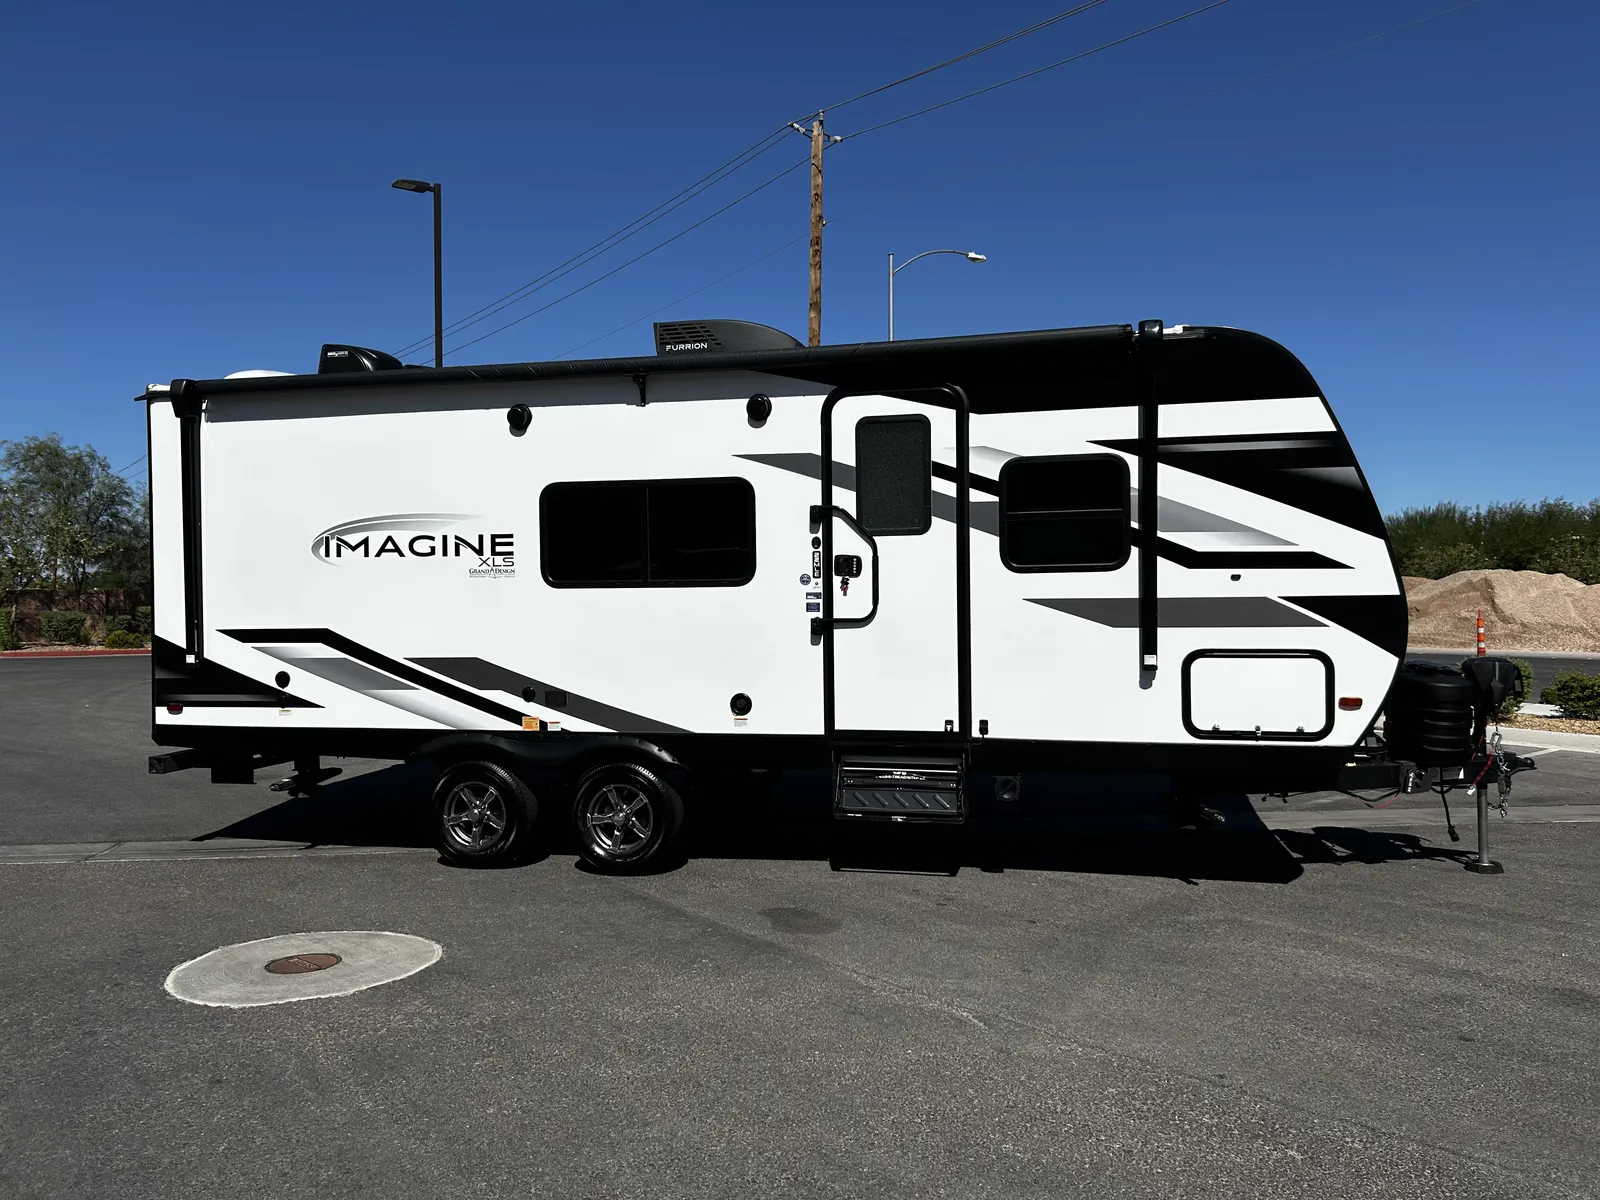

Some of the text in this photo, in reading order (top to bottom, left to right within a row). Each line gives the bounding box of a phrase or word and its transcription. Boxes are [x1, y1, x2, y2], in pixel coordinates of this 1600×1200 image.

[665, 342, 708, 352] FURRION
[323, 533, 514, 558] IMAGINE
[478, 556, 515, 567] XLS
